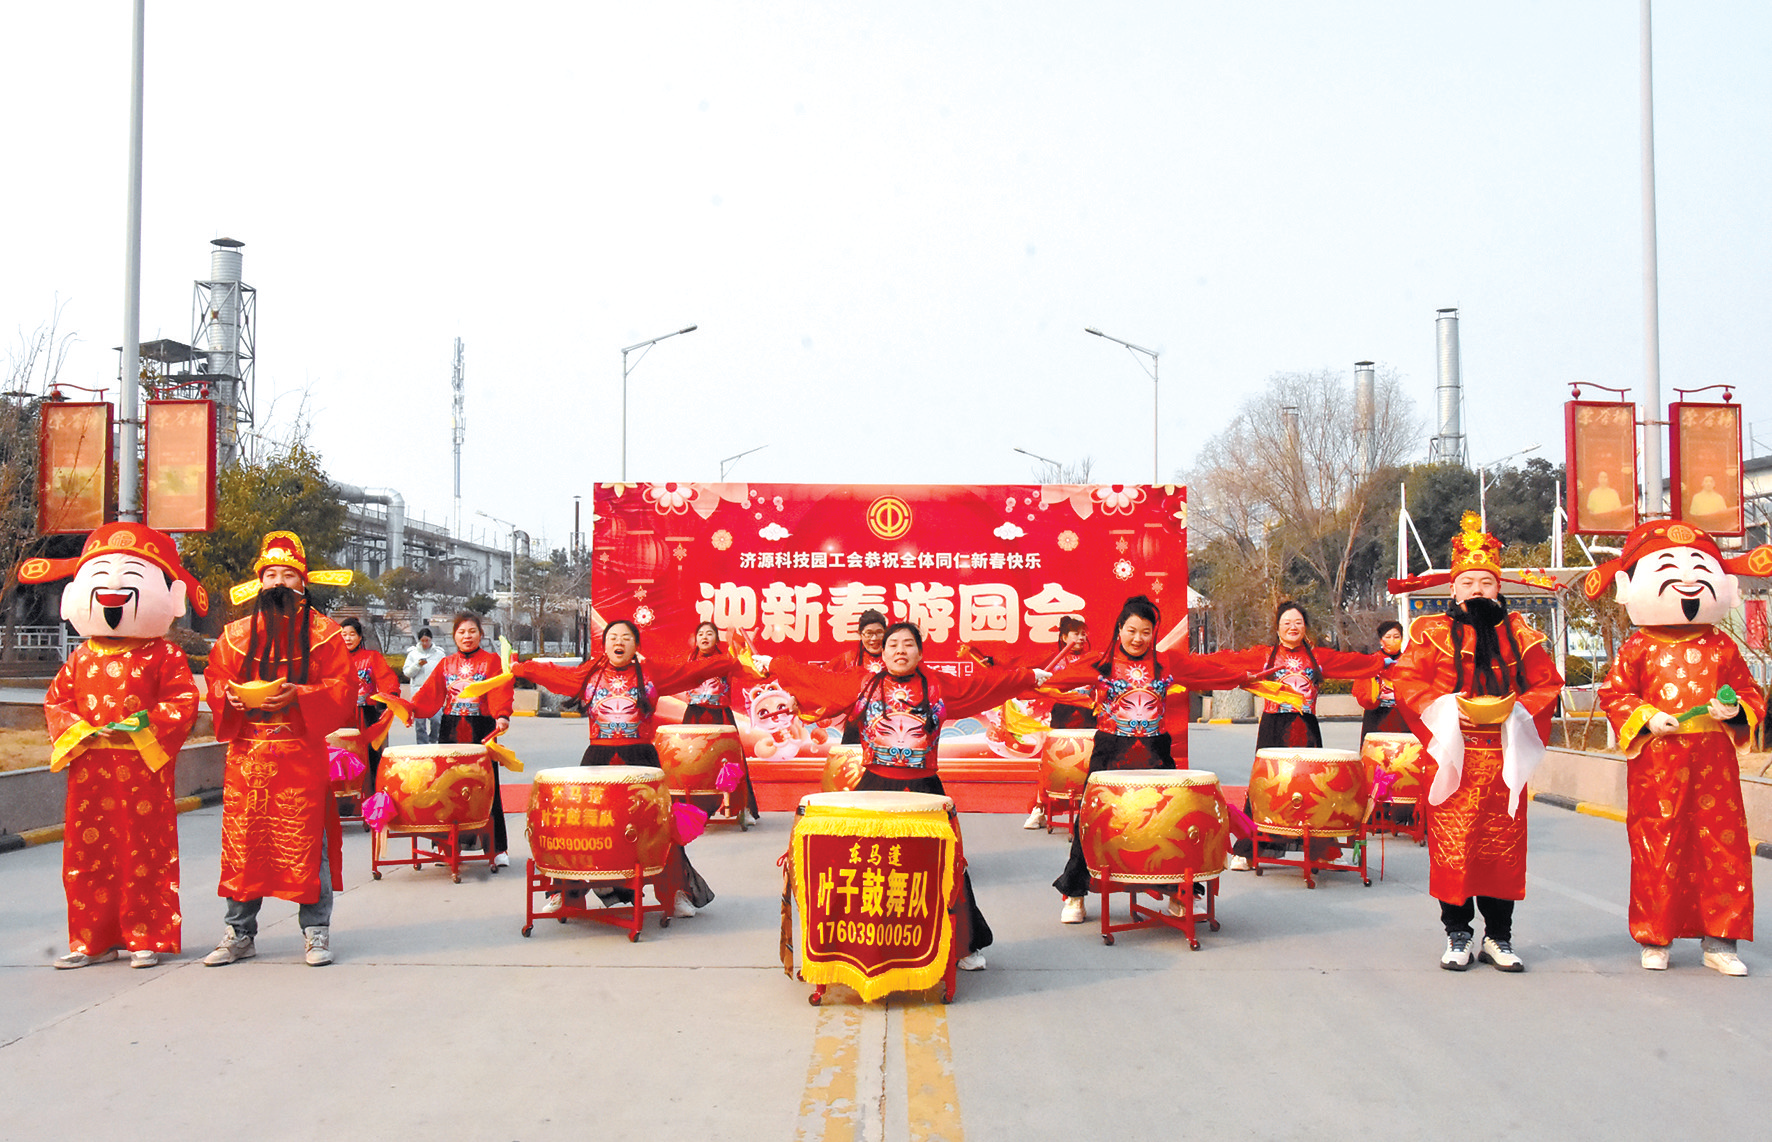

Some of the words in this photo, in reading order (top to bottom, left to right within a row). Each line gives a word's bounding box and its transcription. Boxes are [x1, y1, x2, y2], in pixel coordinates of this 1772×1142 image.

[740, 552, 1042, 569] 济源科技园工会恭祝全体同仁新春快乐
[696, 582, 1086, 643] 迎新春游园会
[541, 807, 615, 827] 叶子鼓舞队
[539, 835, 613, 851] 17603900050
[848, 842, 903, 867] 东马蓬
[817, 867, 929, 918] 叶子鼓舞队
[816, 919, 923, 947] 17603900050
